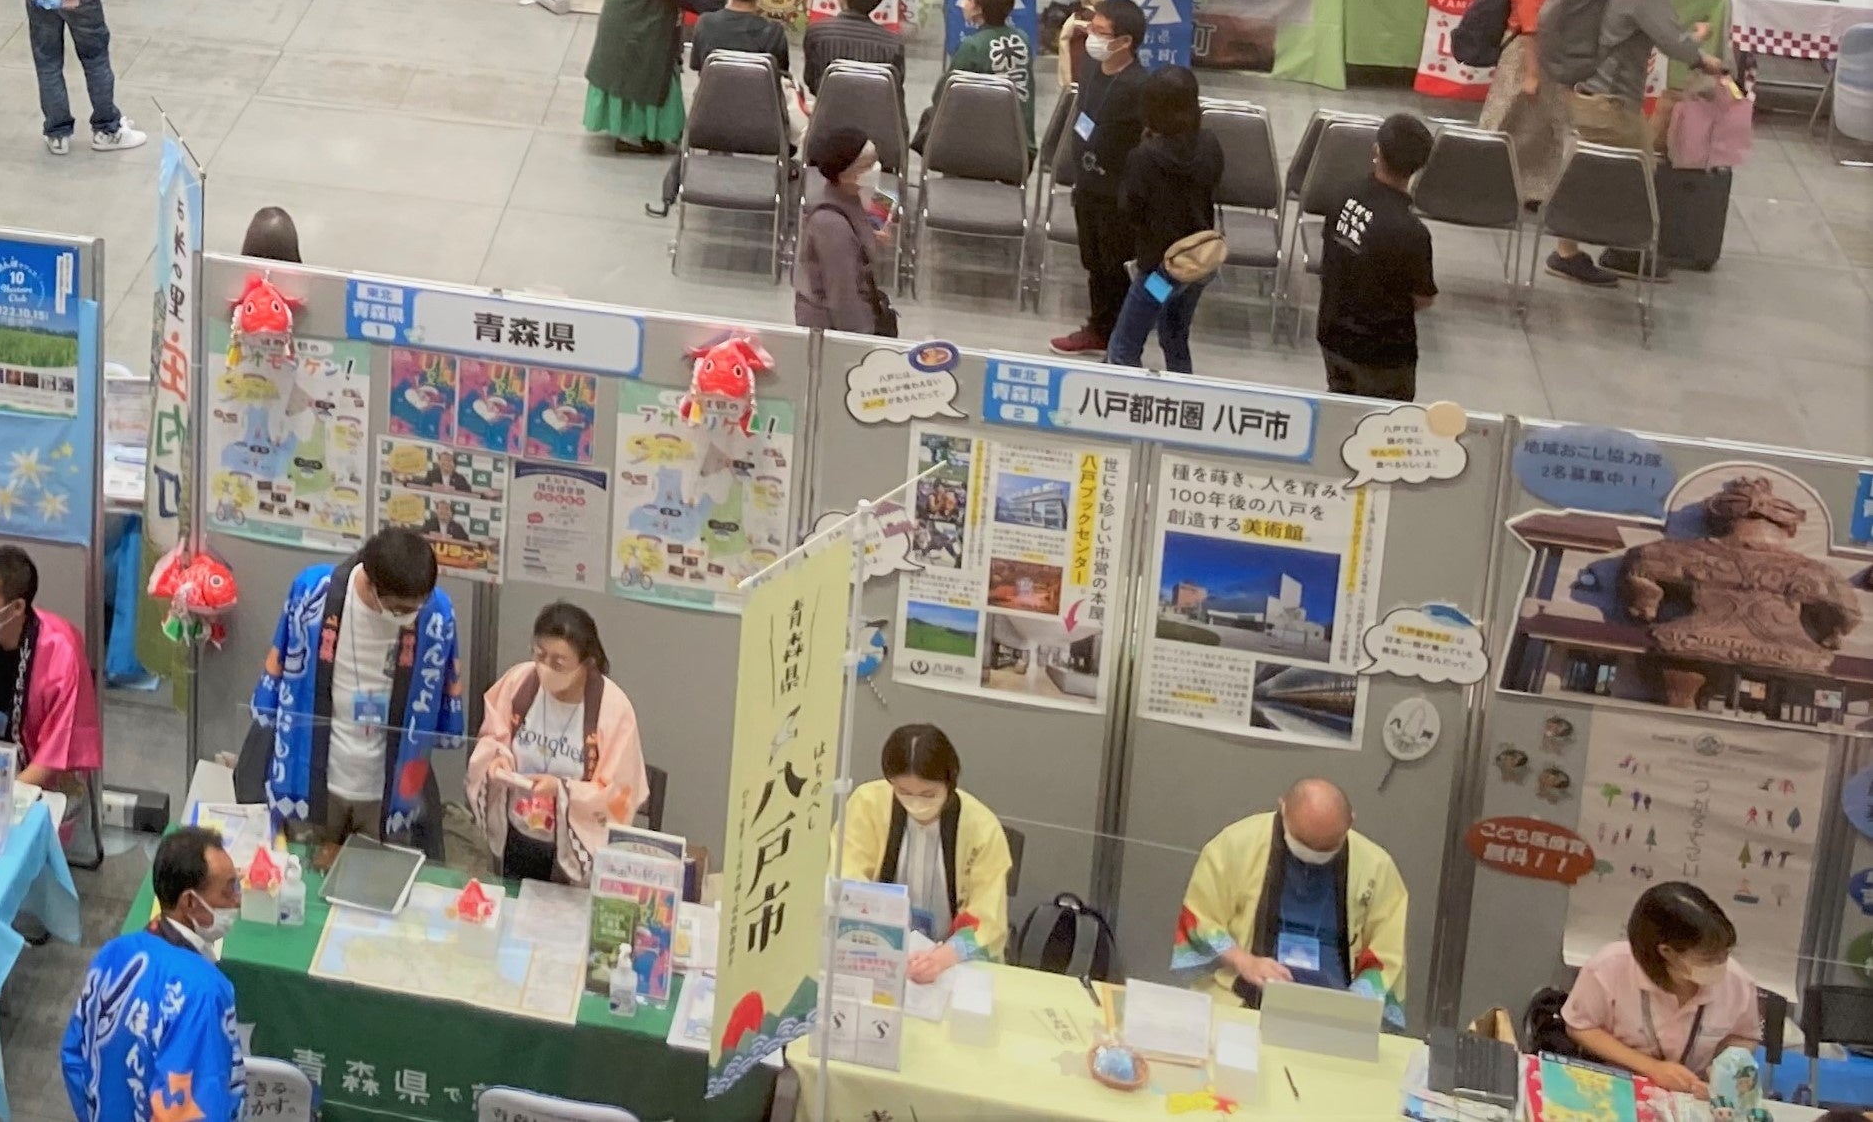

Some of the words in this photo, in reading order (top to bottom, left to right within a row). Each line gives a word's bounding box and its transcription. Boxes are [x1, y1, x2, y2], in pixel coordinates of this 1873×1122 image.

[364, 284, 396, 301] 東北
[353, 300, 405, 325] 青森県
[473, 311, 578, 353] 青森県
[1007, 363, 1041, 382] 東北
[992, 382, 1049, 407] 青森県
[1079, 386, 1203, 433] 八戸都市圏
[1212, 401, 1291, 443] 八戸市
[1523, 439, 1664, 468] 地域おこし協力隊
[1171, 463, 1348, 503] 種を蒔き、人を育み、
[1169, 487, 1325, 521] 100年後の八戸を
[1167, 509, 1313, 542] 創造する美術館。
[1086, 456, 1120, 631] 世にも珍しい市営の本屋、
[778, 596, 807, 695] 青森県
[744, 759, 808, 954] 八戸市
